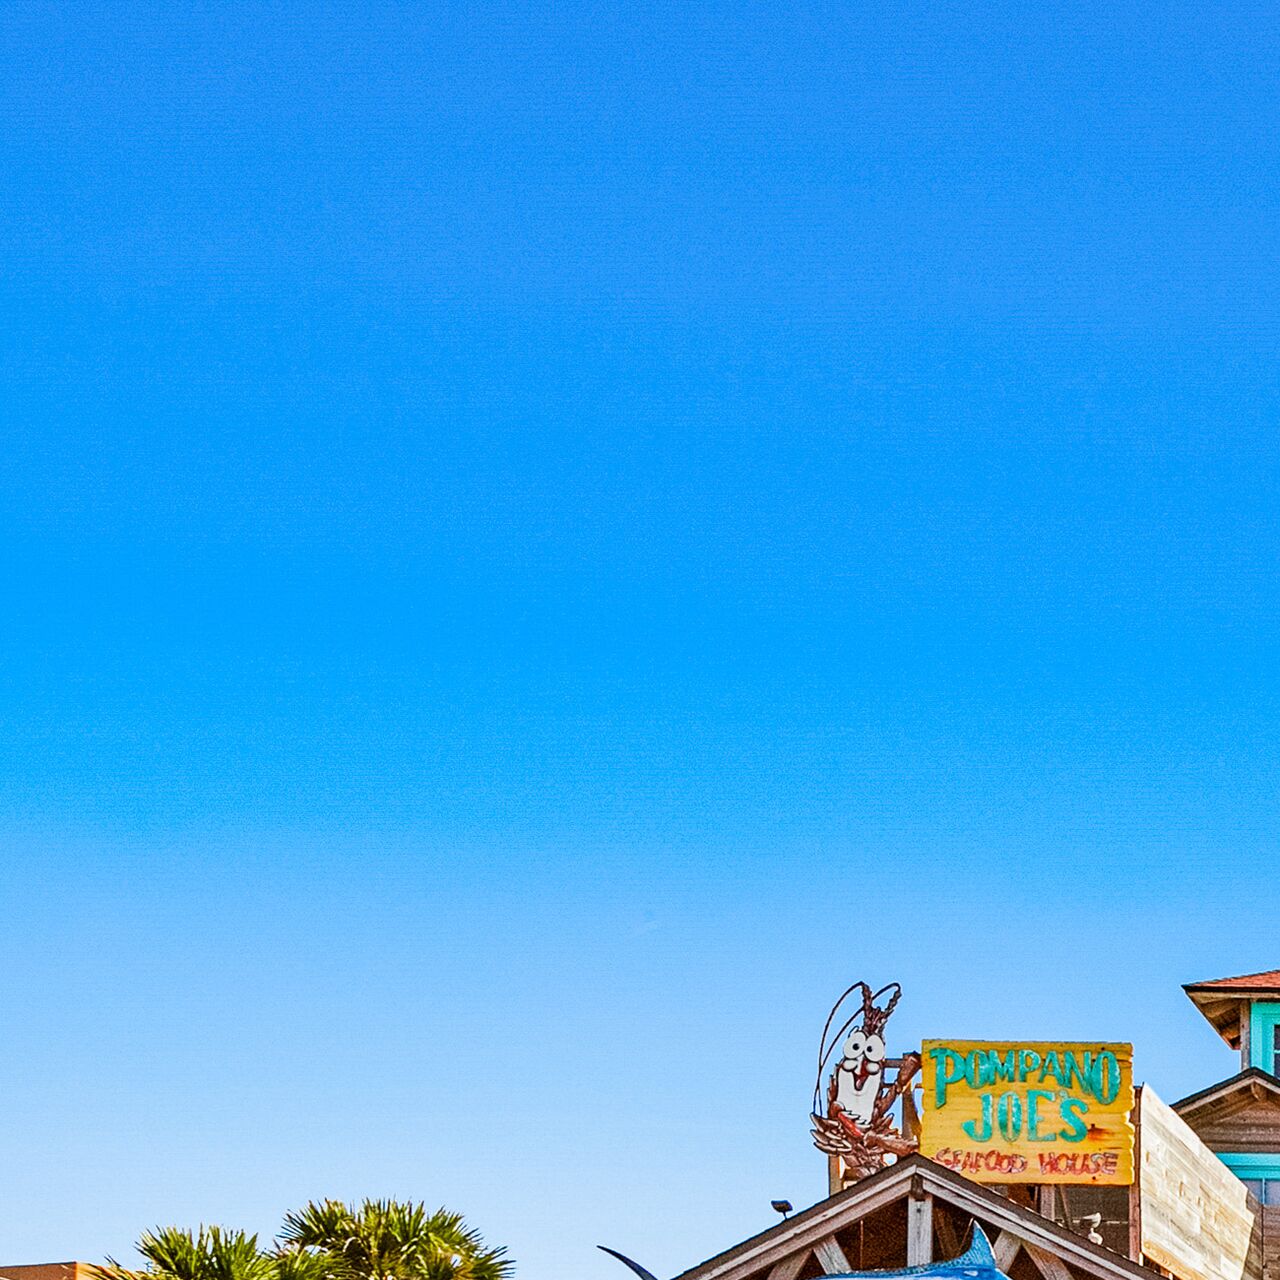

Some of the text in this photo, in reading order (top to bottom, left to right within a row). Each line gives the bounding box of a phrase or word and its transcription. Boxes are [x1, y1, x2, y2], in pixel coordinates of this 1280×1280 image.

[929, 1047, 1122, 1109] POMPANO
[961, 1089, 1089, 1143] JOE'S
[934, 1147, 1119, 1176] SEAFOOD HOUSE
